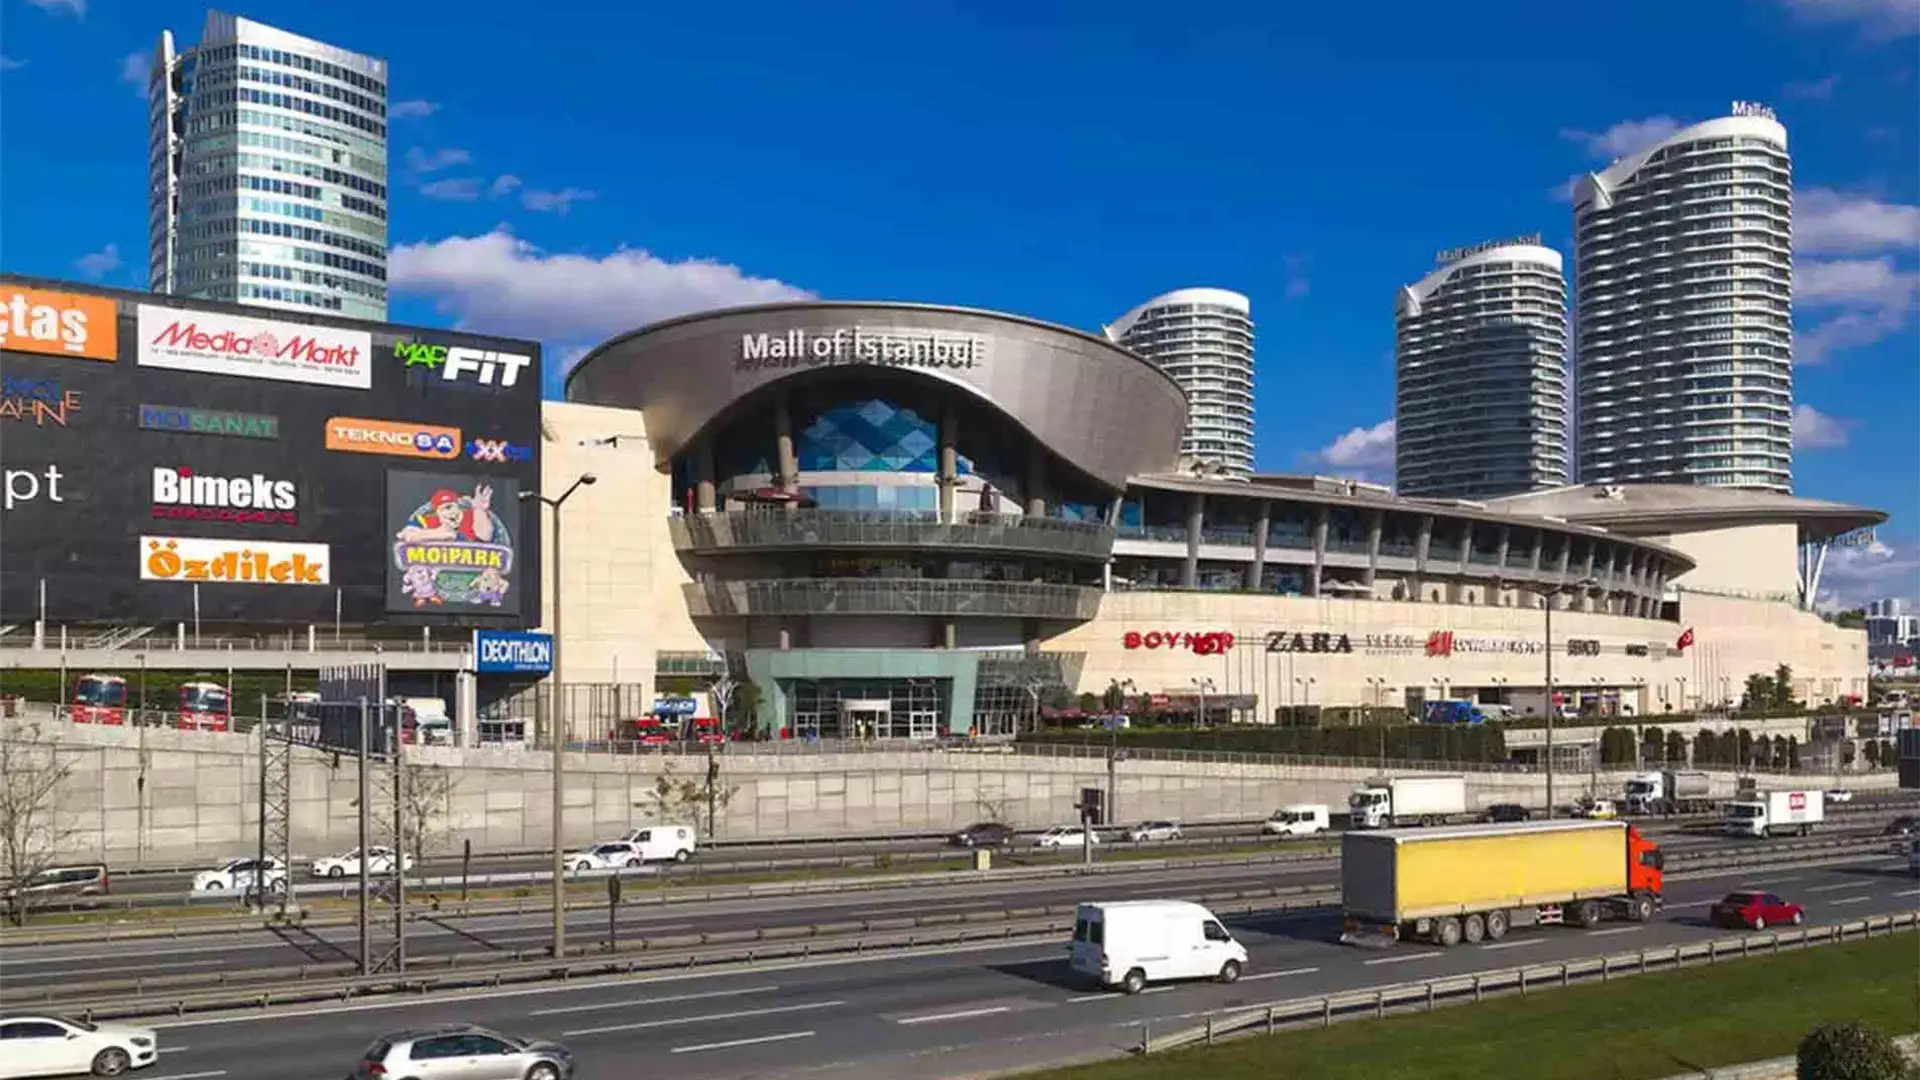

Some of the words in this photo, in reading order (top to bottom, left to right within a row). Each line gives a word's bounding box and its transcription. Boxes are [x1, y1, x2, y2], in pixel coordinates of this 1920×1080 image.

[152, 321, 254, 354] Media
[276, 335, 361, 367] Markt
[742, 329, 804, 360] Mall
[813, 329, 847, 357] of
[334, 426, 453, 451] TEKNOSA
[5, 464, 64, 509] pt
[153, 466, 297, 510] Bimeks
[147, 540, 323, 583] Özdilek
[481, 638, 550, 663] DECATHLON
[1265, 631, 1352, 653] ZARA
